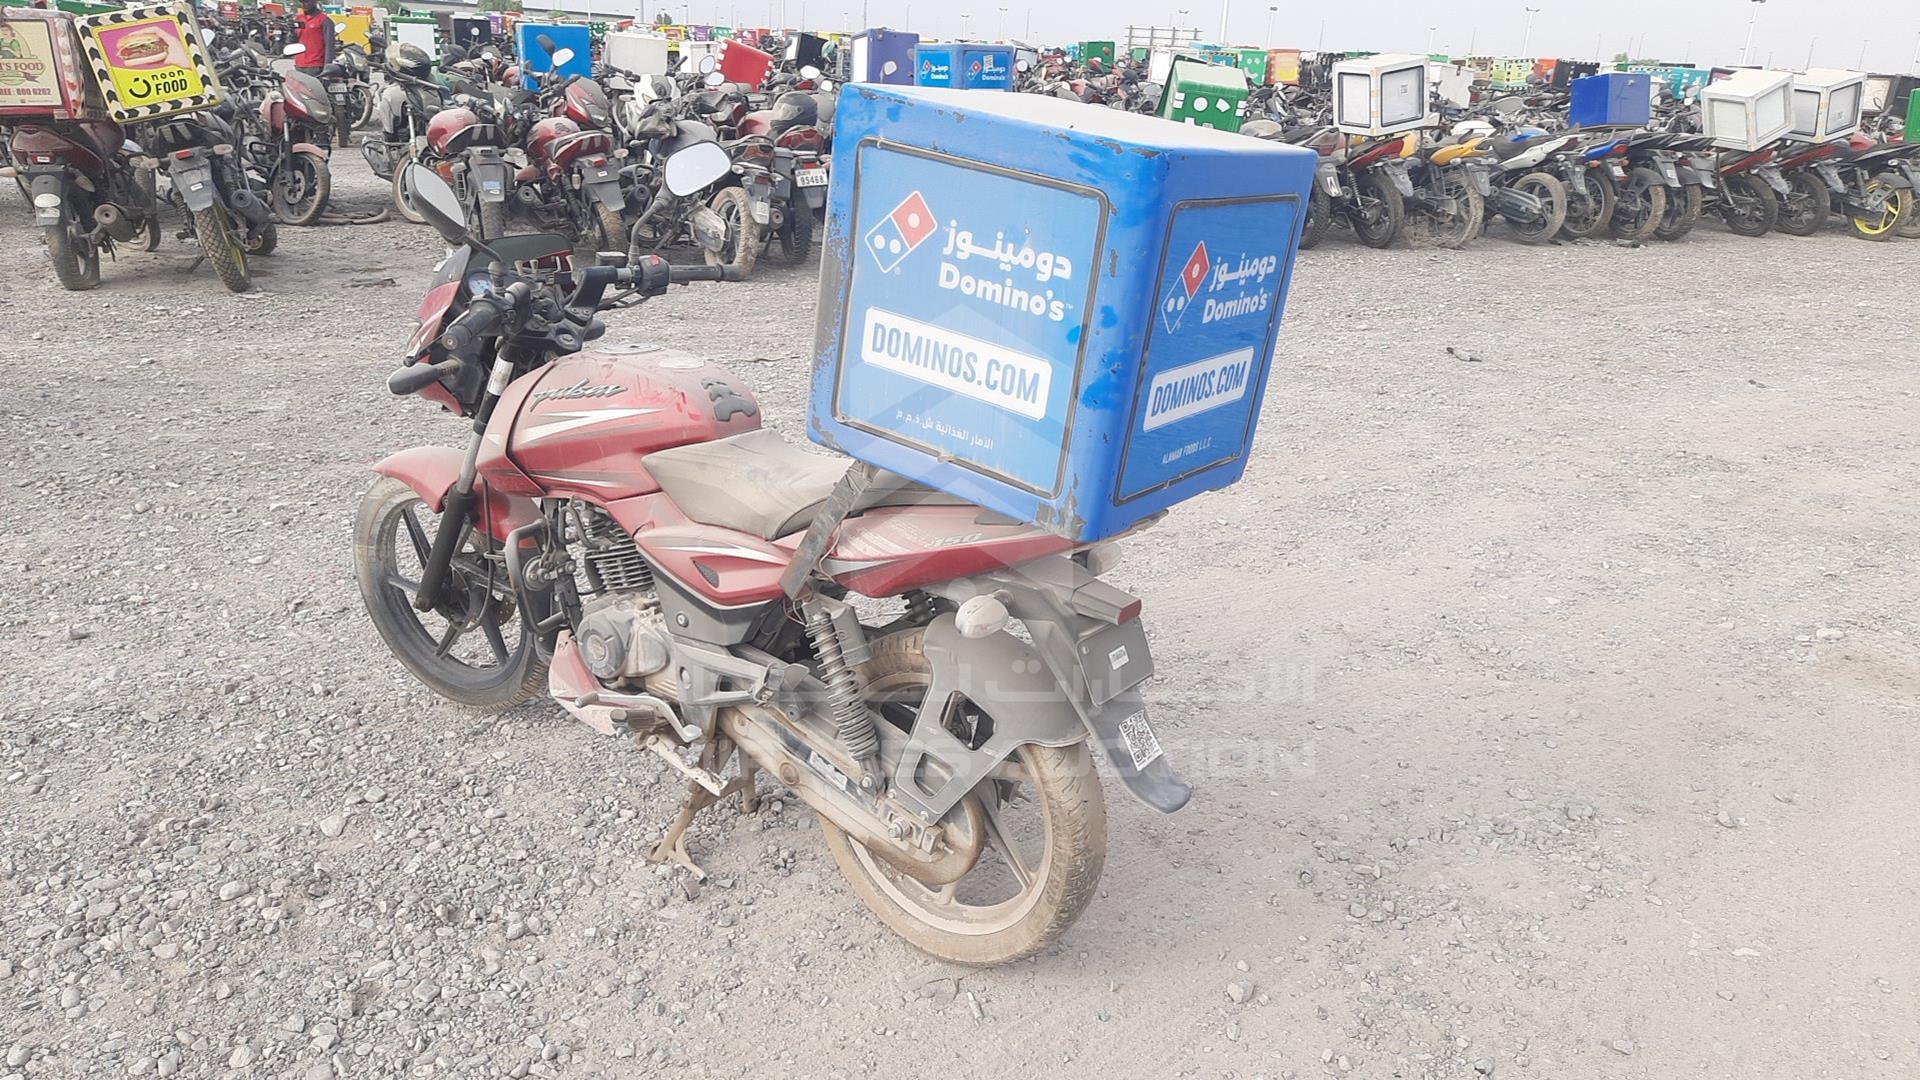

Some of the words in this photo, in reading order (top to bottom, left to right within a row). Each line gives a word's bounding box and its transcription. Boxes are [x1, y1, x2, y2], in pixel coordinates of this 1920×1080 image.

[14, 62, 44, 71] FOOD
[151, 69, 185, 81] noon
[155, 78, 188, 96] FOOD
[943, 219, 1073, 283] دومينوز
[1209, 251, 1277, 293] دومينوز
[939, 261, 1065, 322] Domino's
[1202, 287, 1268, 324] Domino's
[871, 321, 1041, 405] DOMINOS.COM
[1150, 360, 1248, 417] DOMINOS.COM
